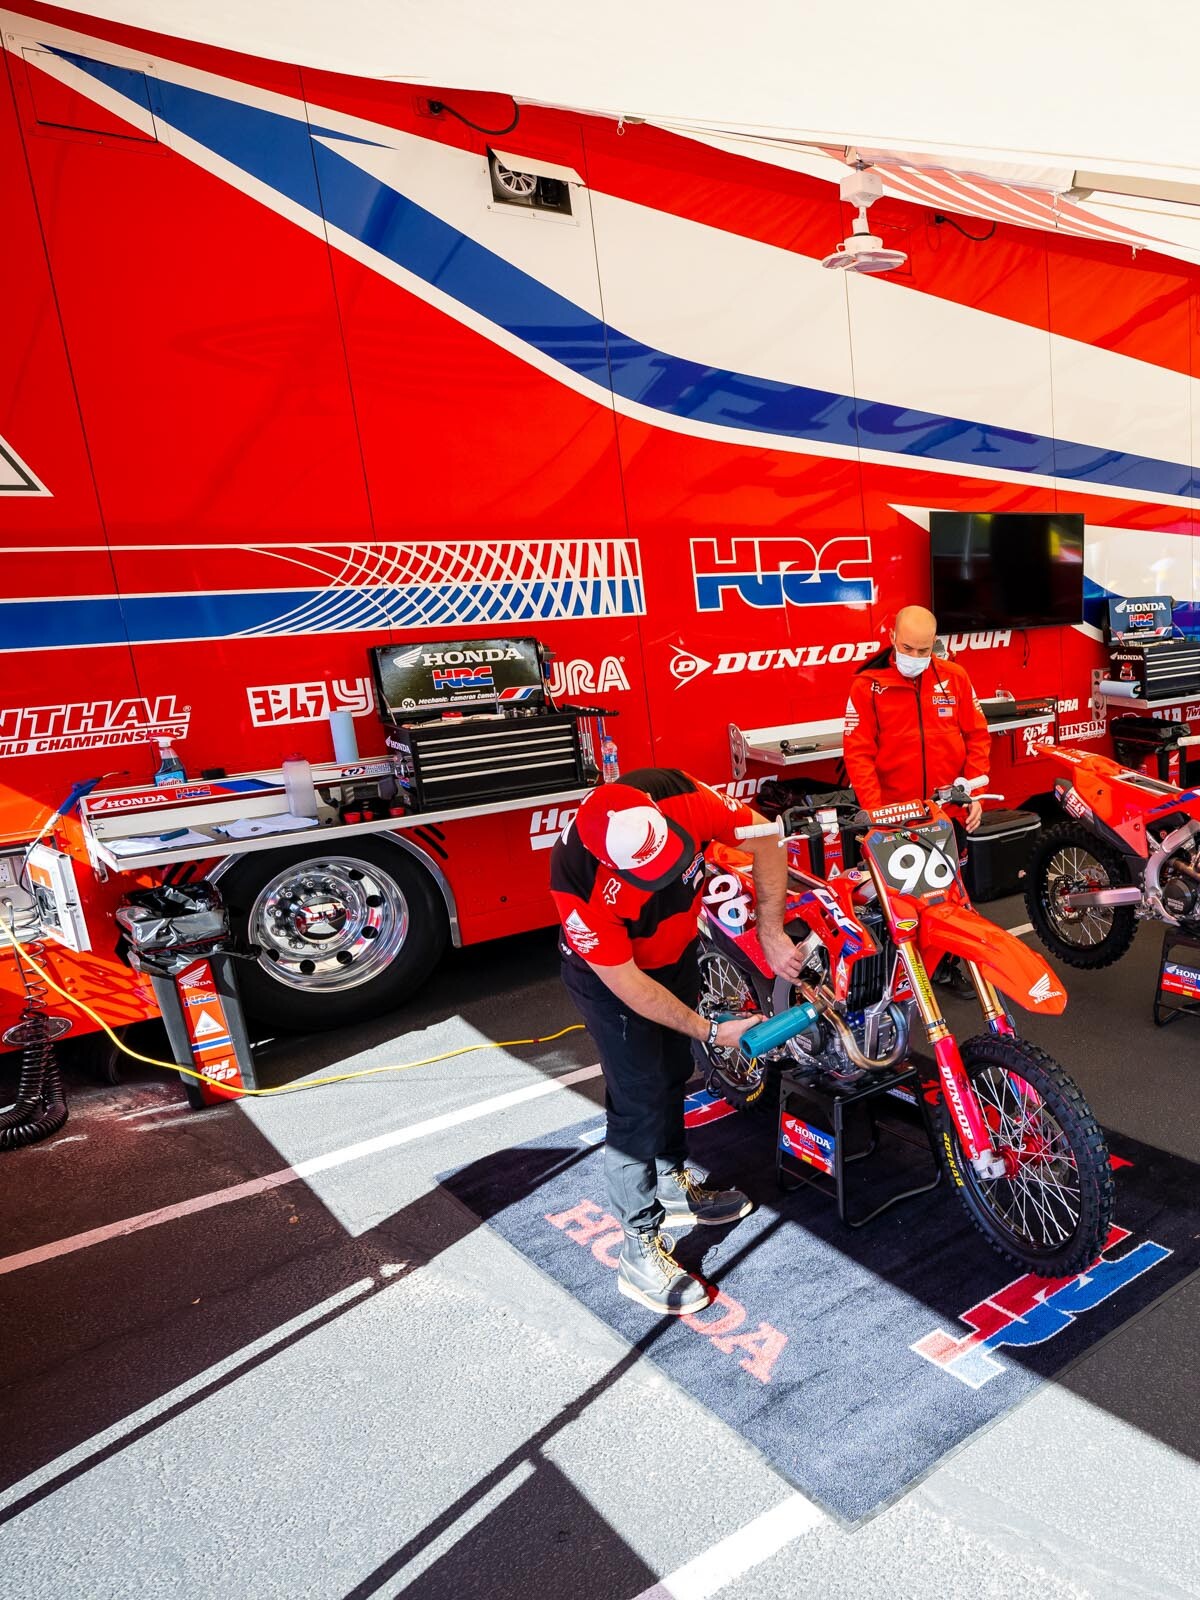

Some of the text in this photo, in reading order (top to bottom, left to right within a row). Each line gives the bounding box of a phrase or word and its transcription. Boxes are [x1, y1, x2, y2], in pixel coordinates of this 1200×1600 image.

[690, 536, 875, 612] HRC
[1126, 602, 1166, 613] HONDA
[1130, 613, 1153, 628] HRC
[423, 647, 524, 667] HONDA
[712, 640, 881, 676] DUNLOP
[432, 666, 494, 690] HRC
[450, 693, 476, 702] Cameron
[1060, 721, 1105, 737] HINSON
[391, 740, 411, 754] HONDA
[106, 794, 168, 809] HONDA
[175, 786, 211, 799] HRC
[872, 802, 919, 818] RENTHAL
[876, 810, 923, 824] RENTHAL
[637, 835, 665, 864] HONDA
[682, 852, 705, 885] HRC
[888, 840, 956, 894] 96
[702, 874, 752, 927] 96
[812, 889, 863, 933] CRF
[201, 1060, 230, 1077] RIDE
[941, 1066, 974, 1140] DUNLOP
[794, 1124, 831, 1150] HONDA
[943, 1131, 965, 1187] DUNLOP
[543, 1199, 789, 1385] HDA
